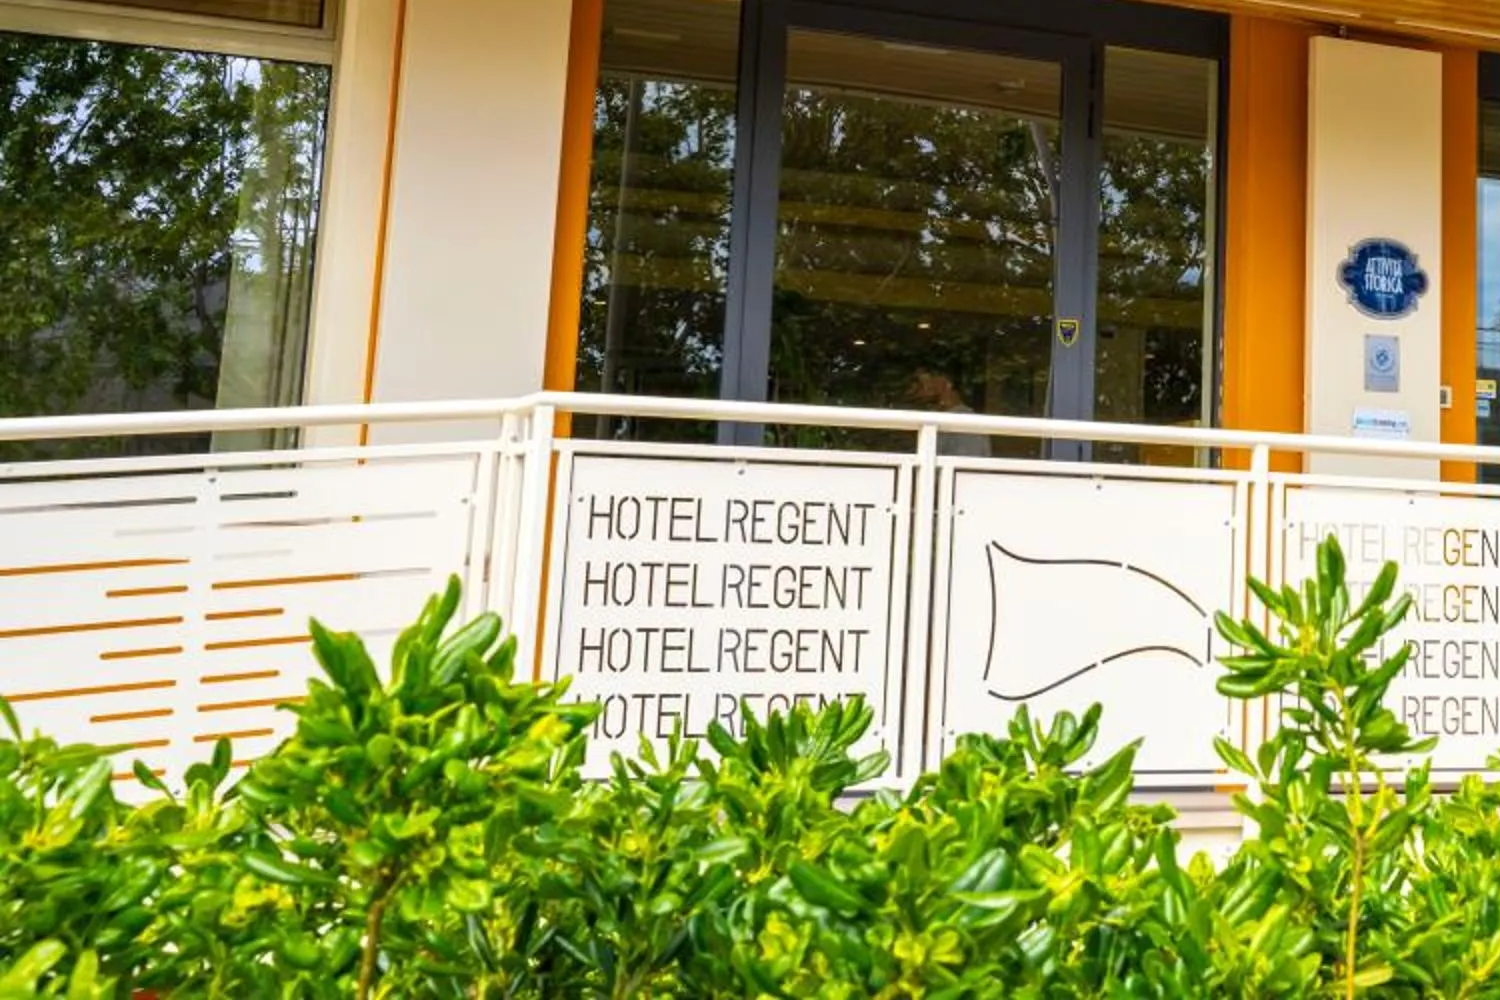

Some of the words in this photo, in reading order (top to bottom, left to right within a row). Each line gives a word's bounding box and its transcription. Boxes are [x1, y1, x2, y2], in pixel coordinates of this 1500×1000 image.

[588, 495, 718, 542] HOTEL
[725, 499, 875, 546] REGENT
[583, 561, 713, 608] HOTEL
[721, 564, 872, 610] REGENT
[578, 627, 710, 673] HOTEL
[717, 628, 869, 673] REGENT
